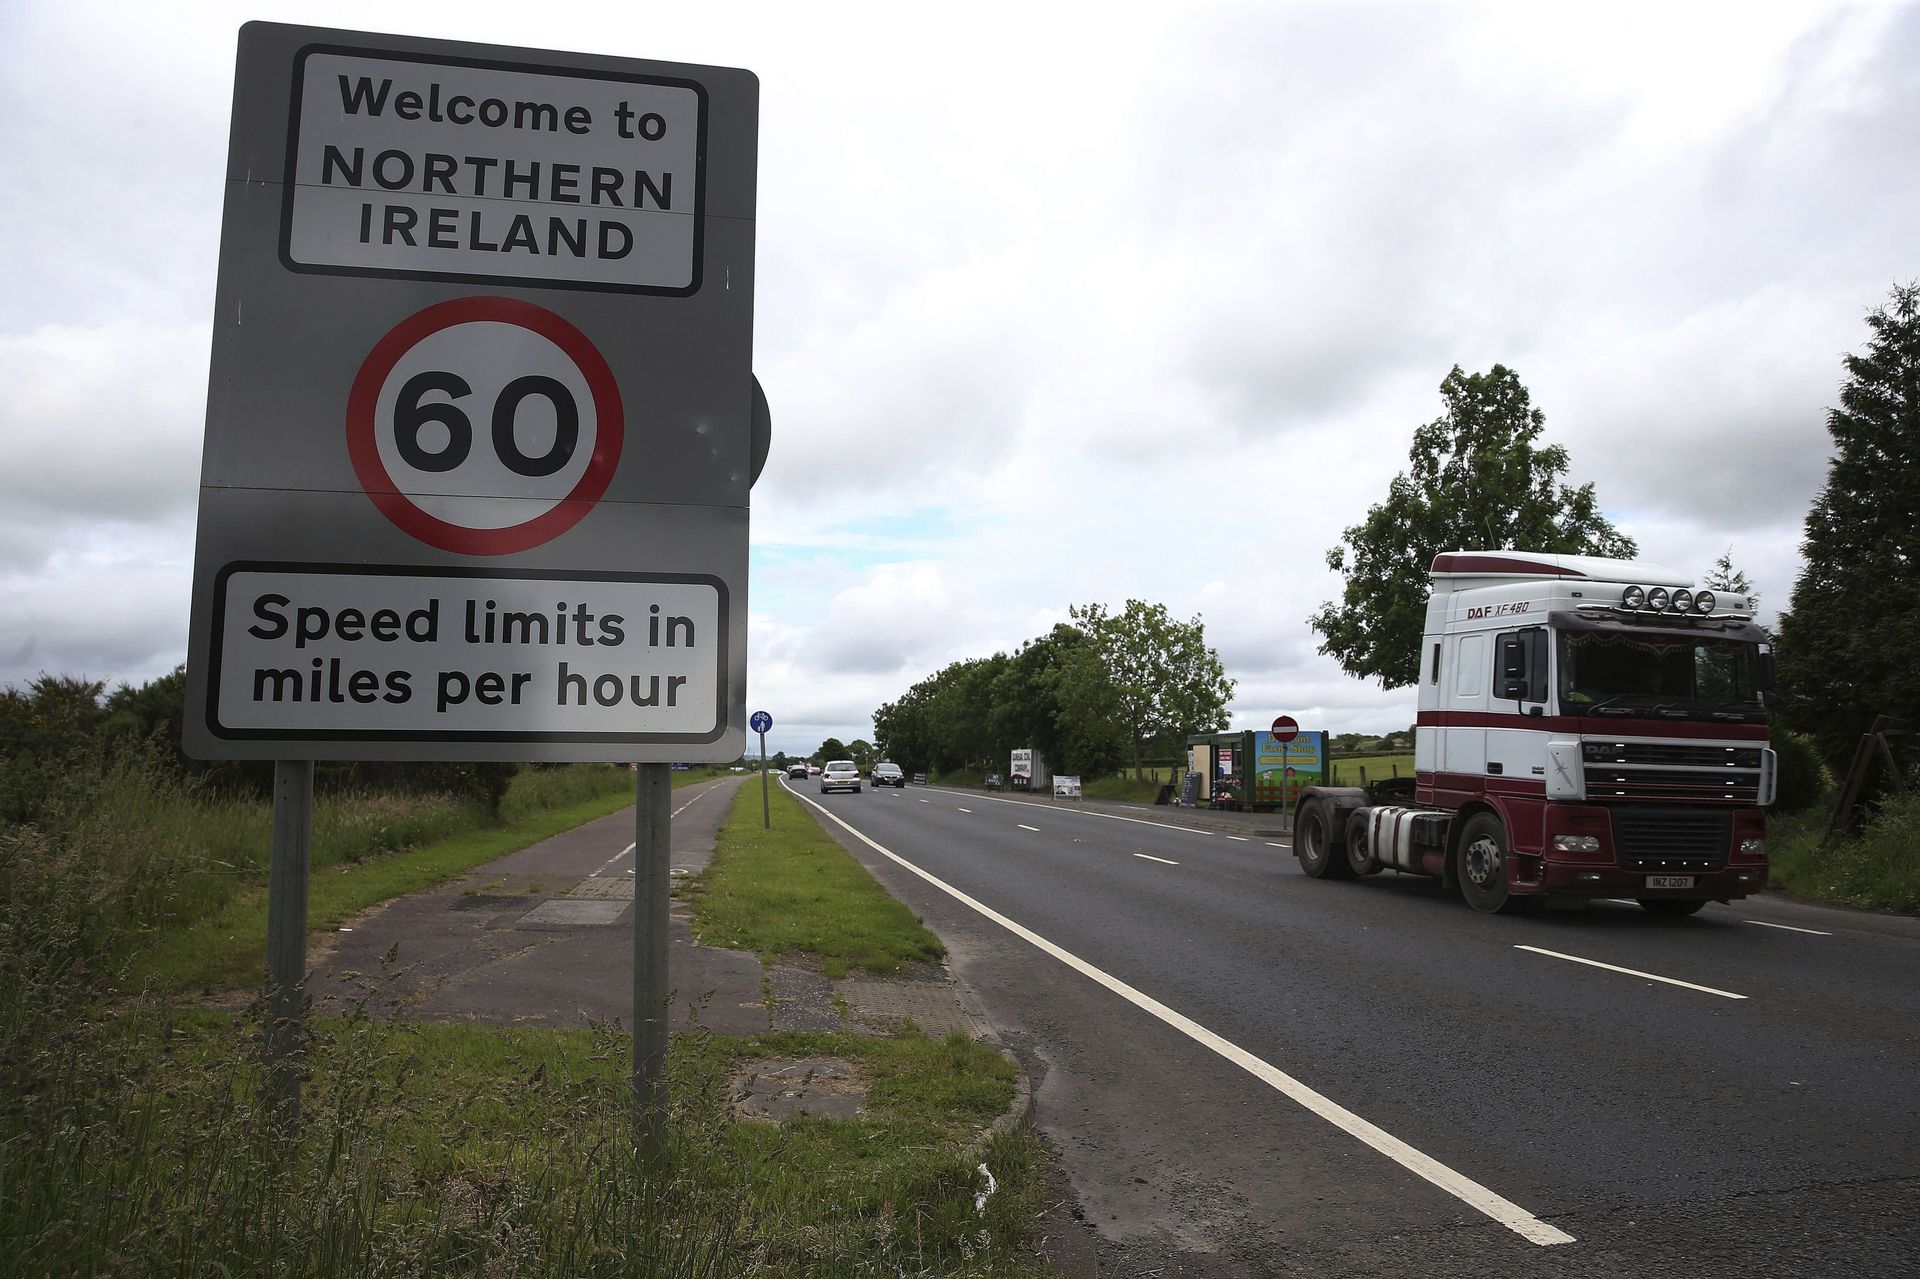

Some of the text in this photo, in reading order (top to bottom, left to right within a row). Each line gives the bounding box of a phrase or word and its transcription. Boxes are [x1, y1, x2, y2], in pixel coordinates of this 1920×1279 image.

[338, 74, 667, 141] Welcome to
[321, 144, 673, 210] NORTHERN
[359, 202, 634, 260] IRELAND
[393, 371, 579, 477] 60
[247, 593, 696, 649] Speed limits in
[1467, 601, 1530, 620] DAF XF 480
[252, 658, 687, 713] miles per hour
[1652, 877, 1689, 887] INZ 1207
